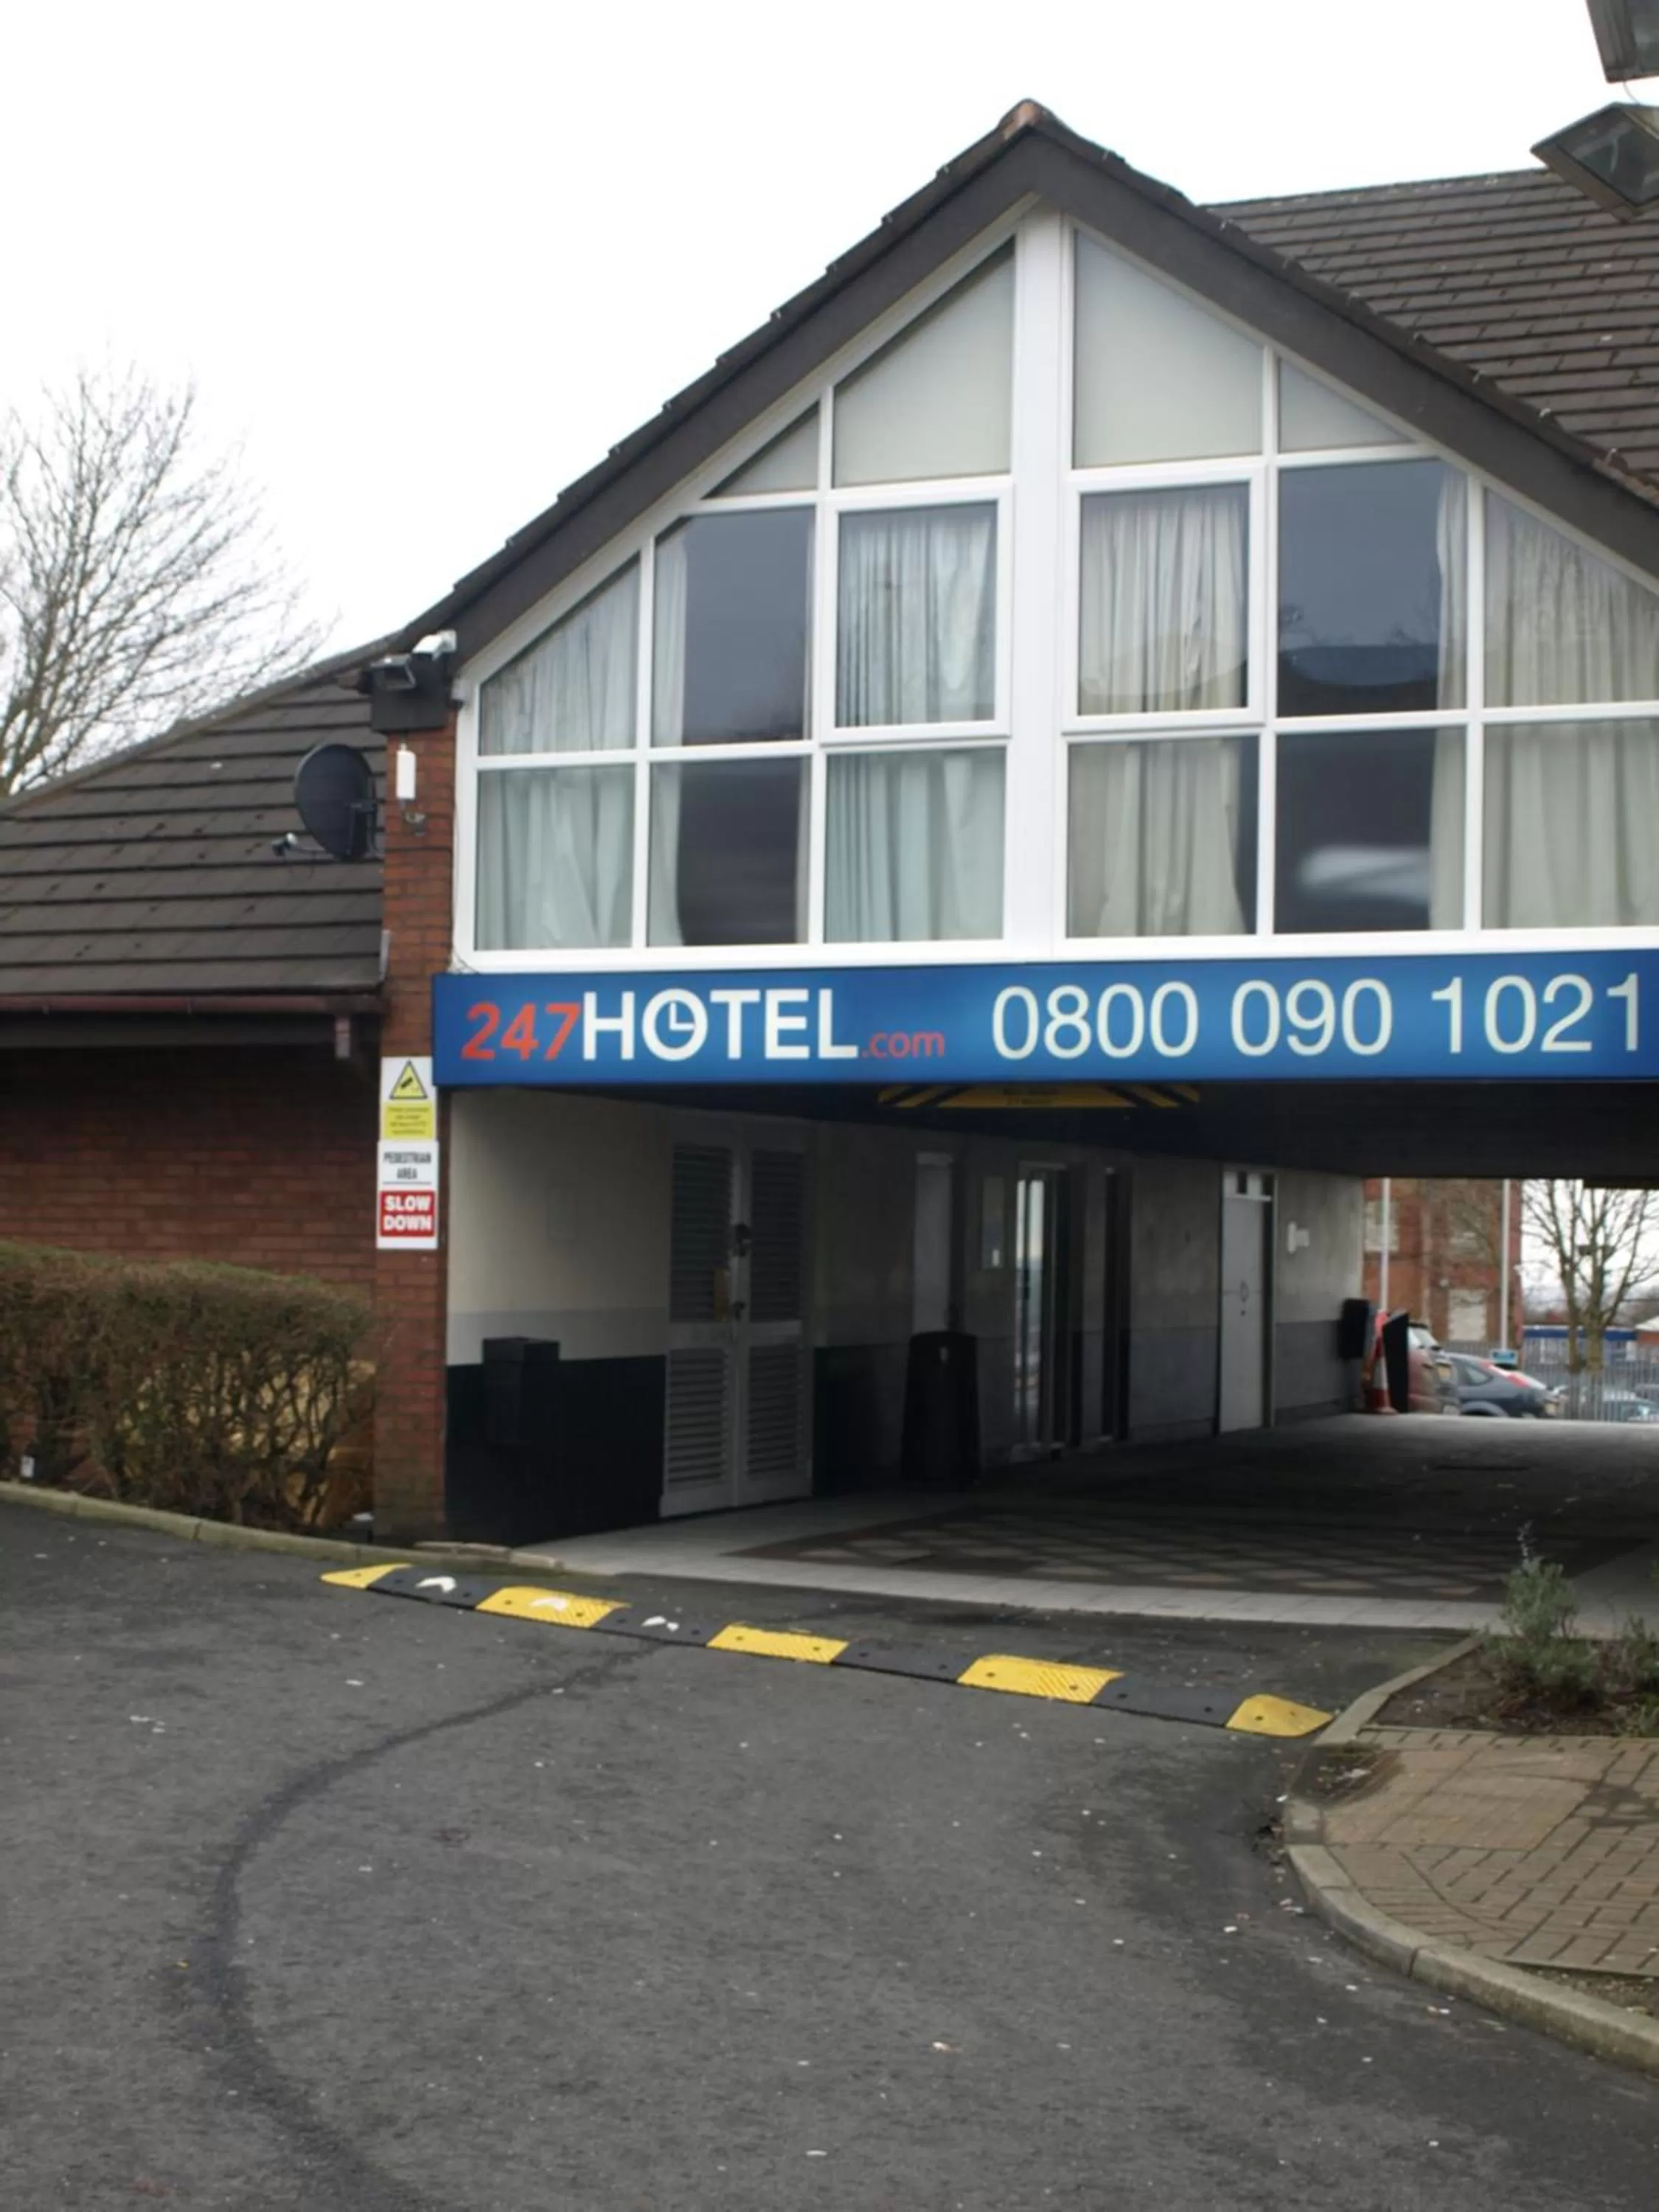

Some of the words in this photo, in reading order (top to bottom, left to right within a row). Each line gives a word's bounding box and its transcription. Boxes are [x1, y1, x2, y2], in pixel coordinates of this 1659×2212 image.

[992, 981, 1199, 1060] 0800
[1230, 978, 1394, 1056] 090
[1430, 972, 1641, 1054] 1021
[396, 1167, 418, 1180] AREA
[384, 1194, 432, 1211] SLOW
[383, 1214, 432, 1232] DOWN
